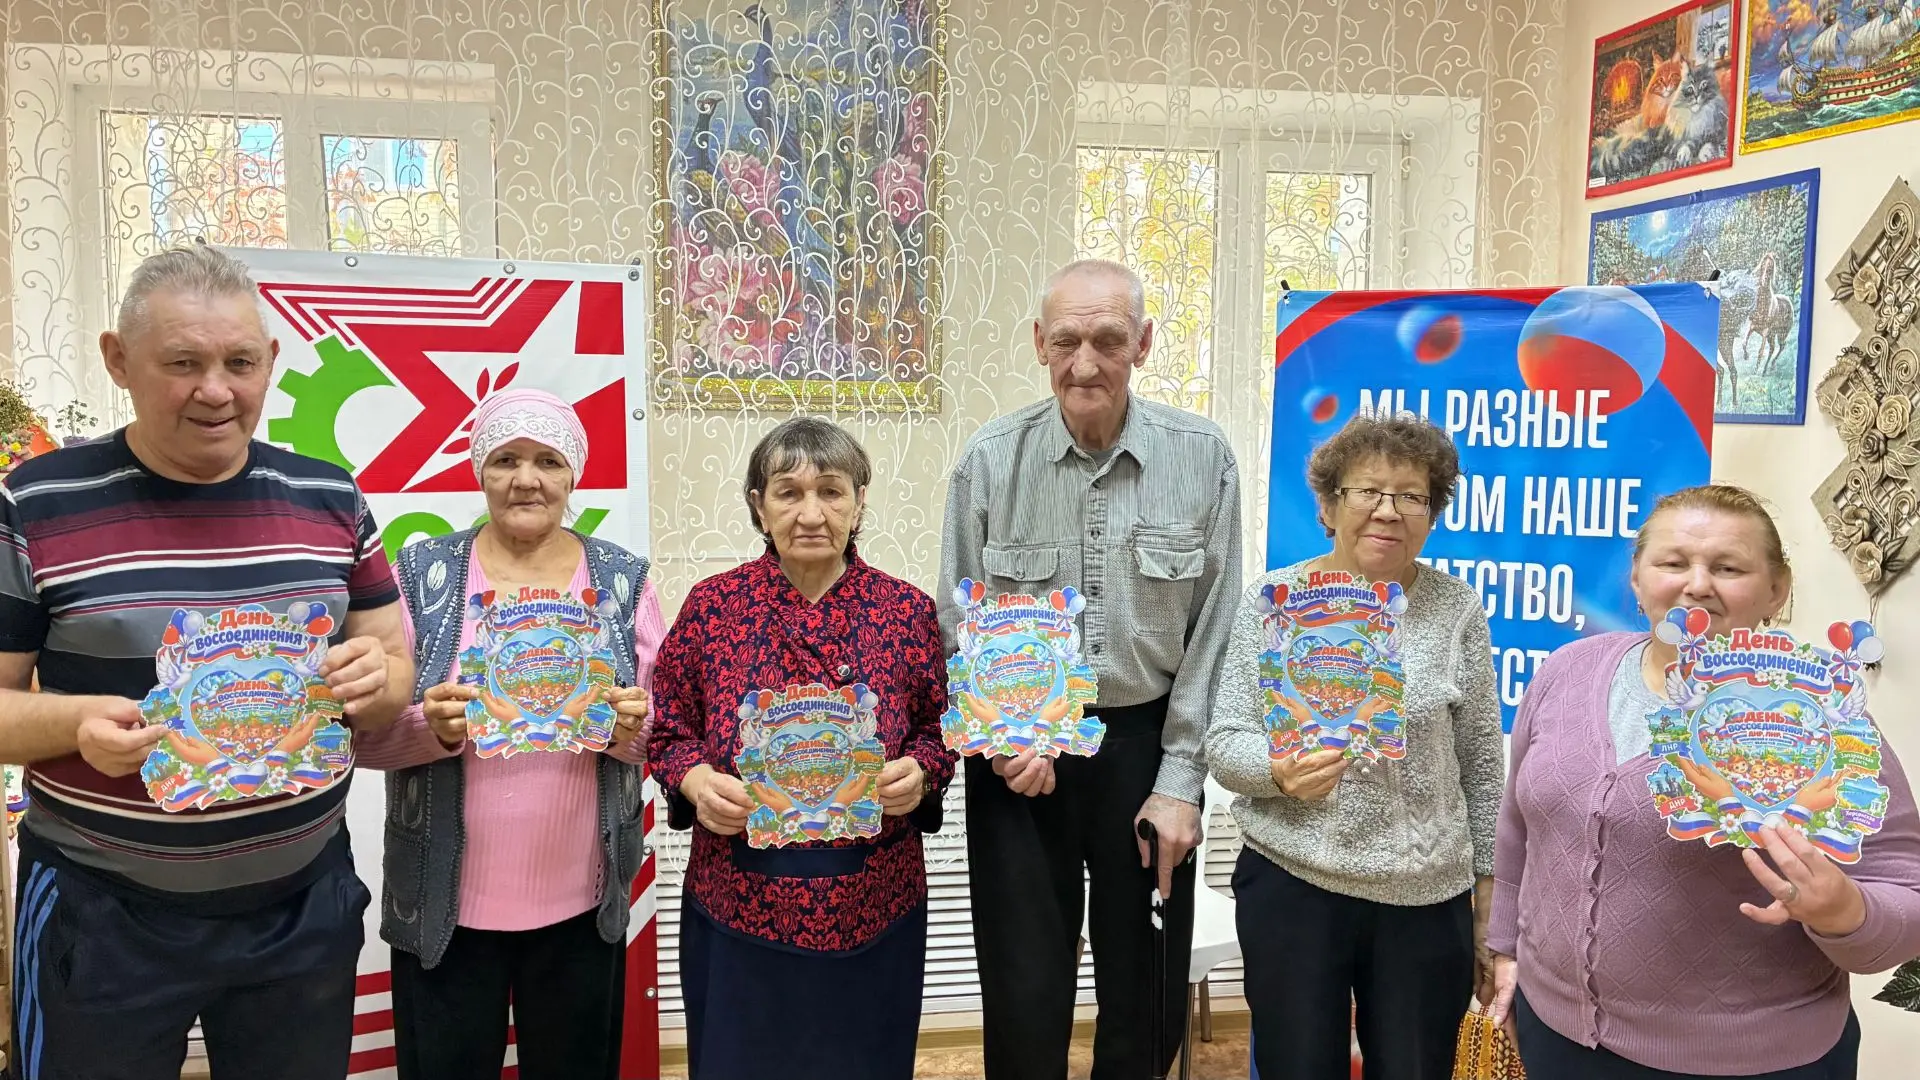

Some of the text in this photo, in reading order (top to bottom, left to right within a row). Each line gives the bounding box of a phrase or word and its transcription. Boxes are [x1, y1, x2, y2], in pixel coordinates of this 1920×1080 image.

[1444, 389, 1610, 448] РАЗНЫЕ
[1431, 474, 1641, 538] ОМ НАШЕ
[1308, 571, 1353, 588] День
[518, 586, 561, 603] День
[997, 593, 1036, 609] День
[219, 609, 275, 629] День
[1730, 630, 1794, 652] День
[786, 685, 829, 701] День
[1744, 711, 1786, 723] ДЕНЬ
[1727, 723, 1804, 736] ВОССОЕДИНЕНИЯ
[1661, 743, 1678, 752] ЛНР
[160, 777, 176, 792] ДНР
[1669, 799, 1685, 809] ДНР
